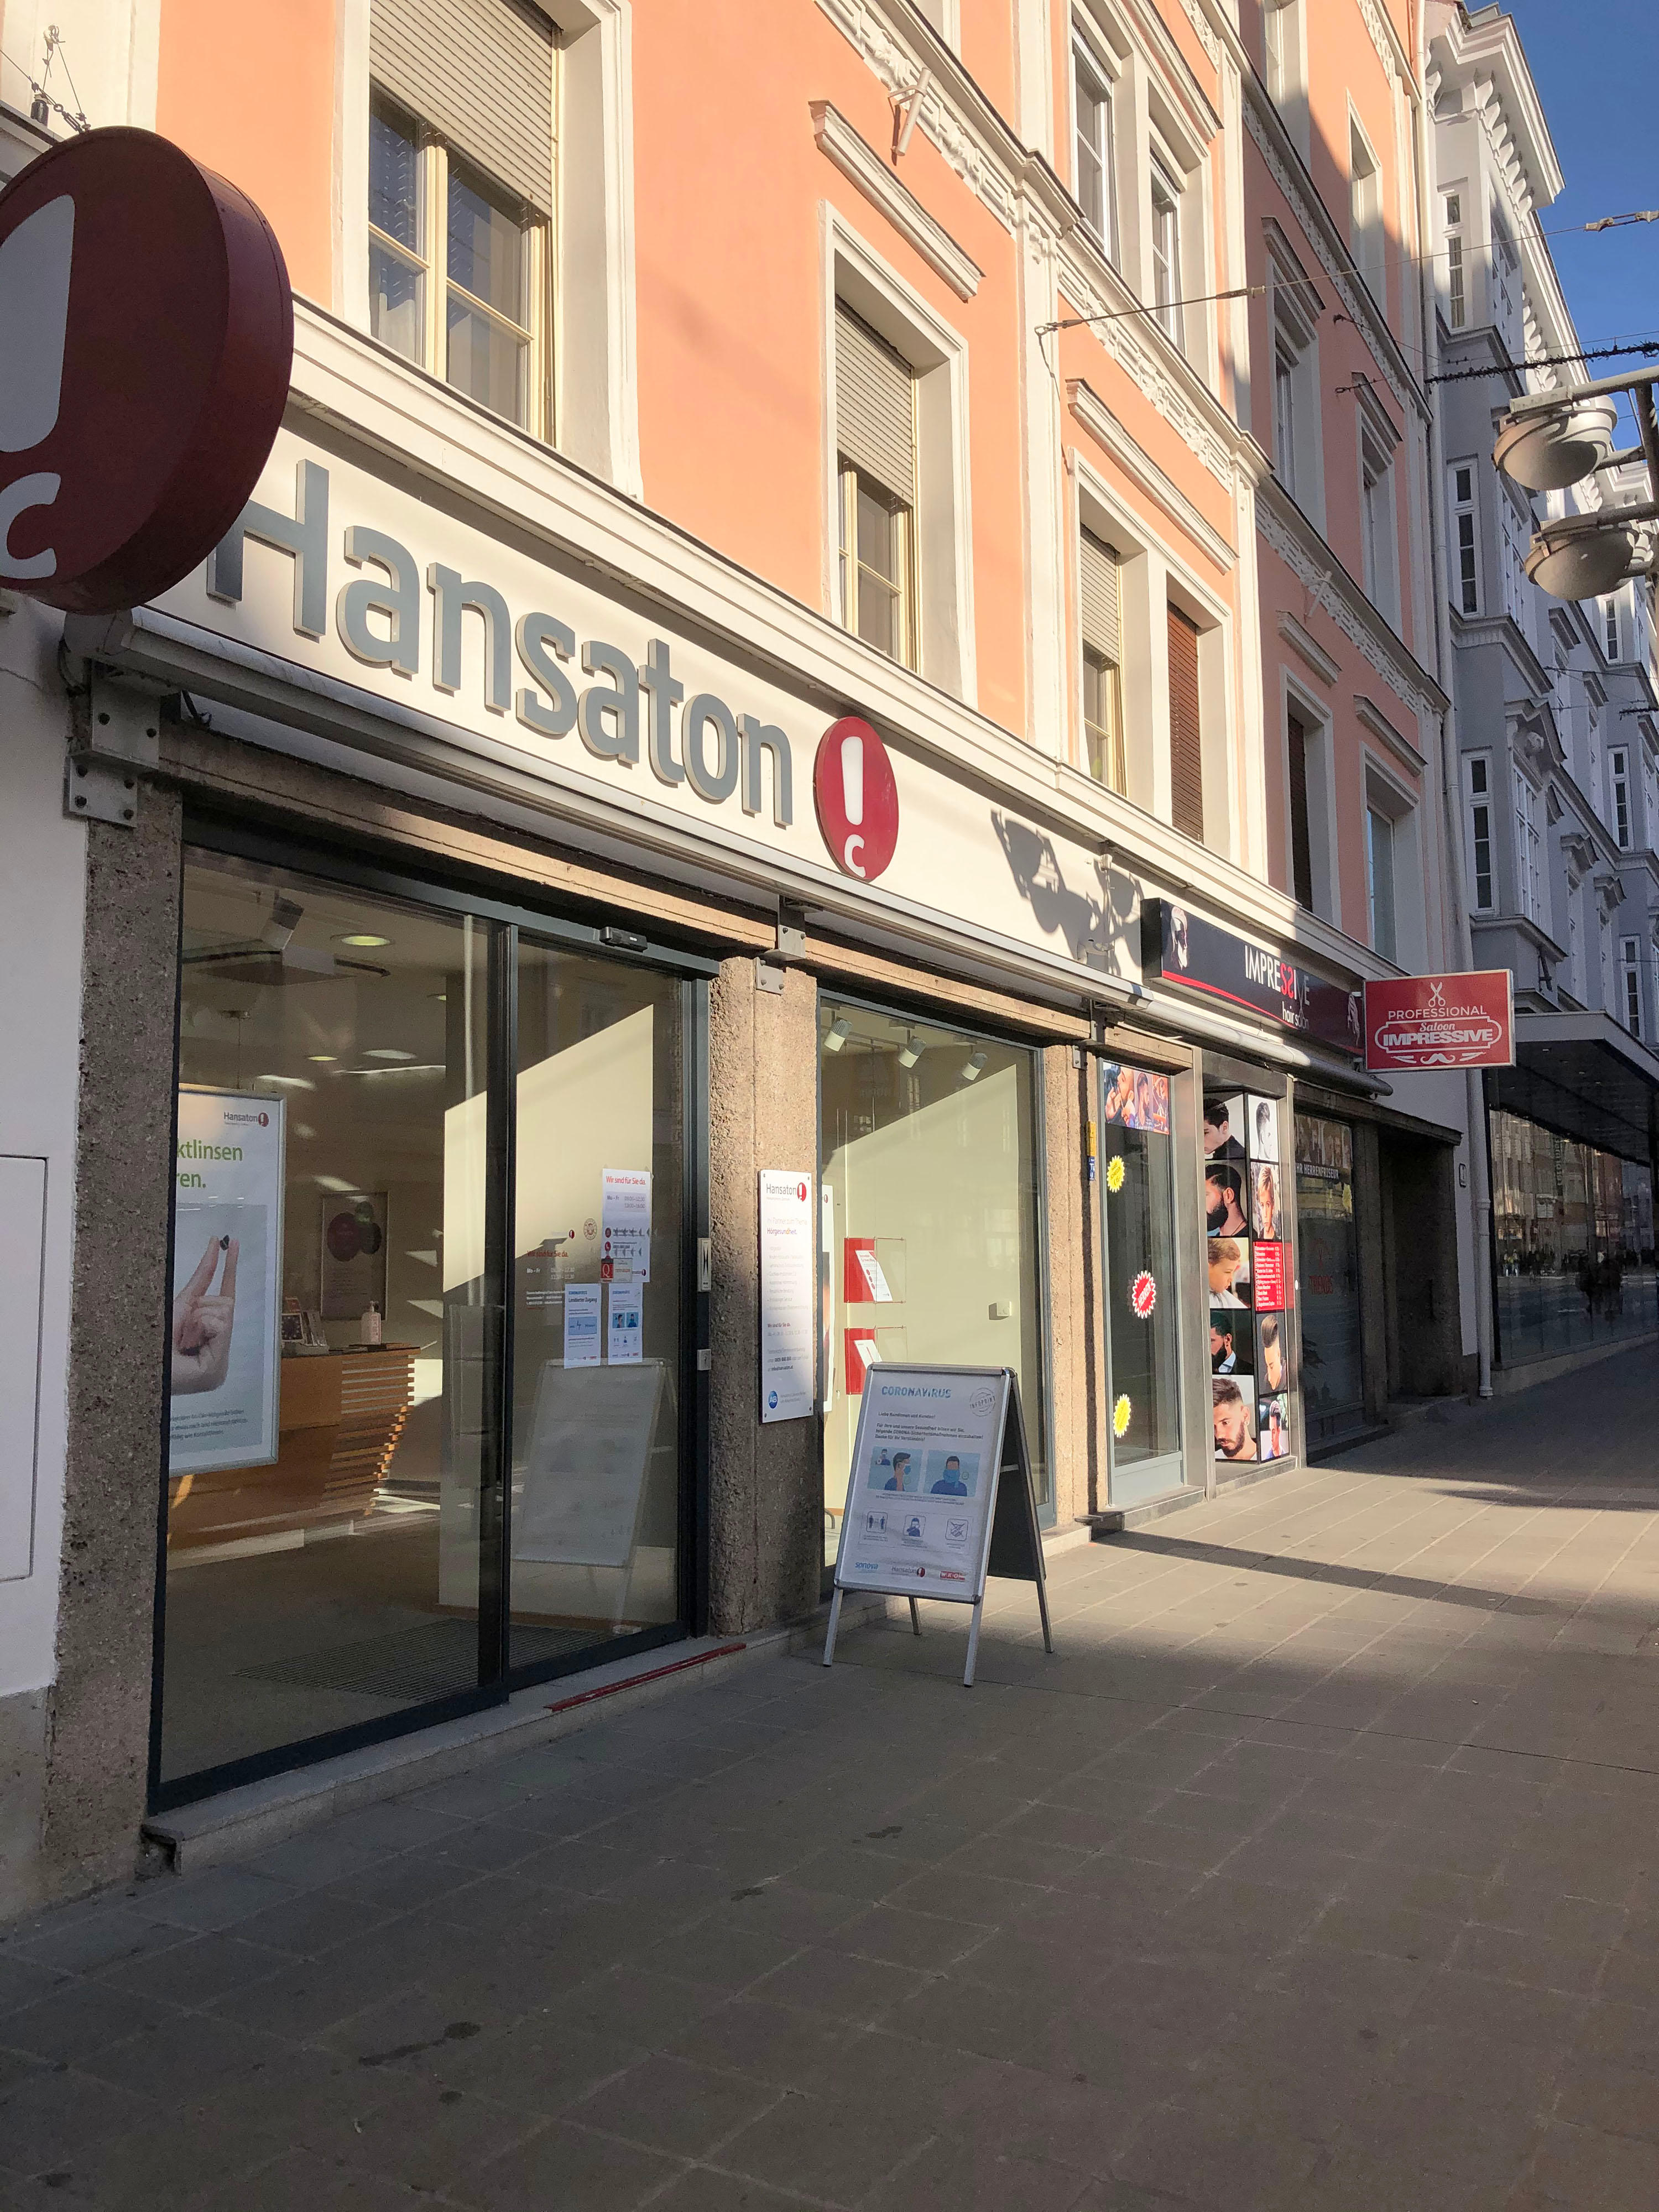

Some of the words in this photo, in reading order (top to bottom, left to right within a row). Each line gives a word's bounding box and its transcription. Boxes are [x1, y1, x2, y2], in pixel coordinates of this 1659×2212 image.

[206, 458, 793, 830] Hansaton
[1282, 1001, 1294, 1024] hair
[1388, 1005, 1486, 1020] PROFESSIONAL
[1419, 1022, 1455, 1032] Saloon
[1383, 1029, 1493, 1046] IMPRESSIVE
[223, 1112, 258, 1123] Hansaton
[177, 1138, 243, 1161] ktlinsen
[1303, 1164, 1339, 1180] HERRENFRISEUR
[176, 1173, 206, 1188] en.
[766, 1183, 797, 1196] Hansaton
